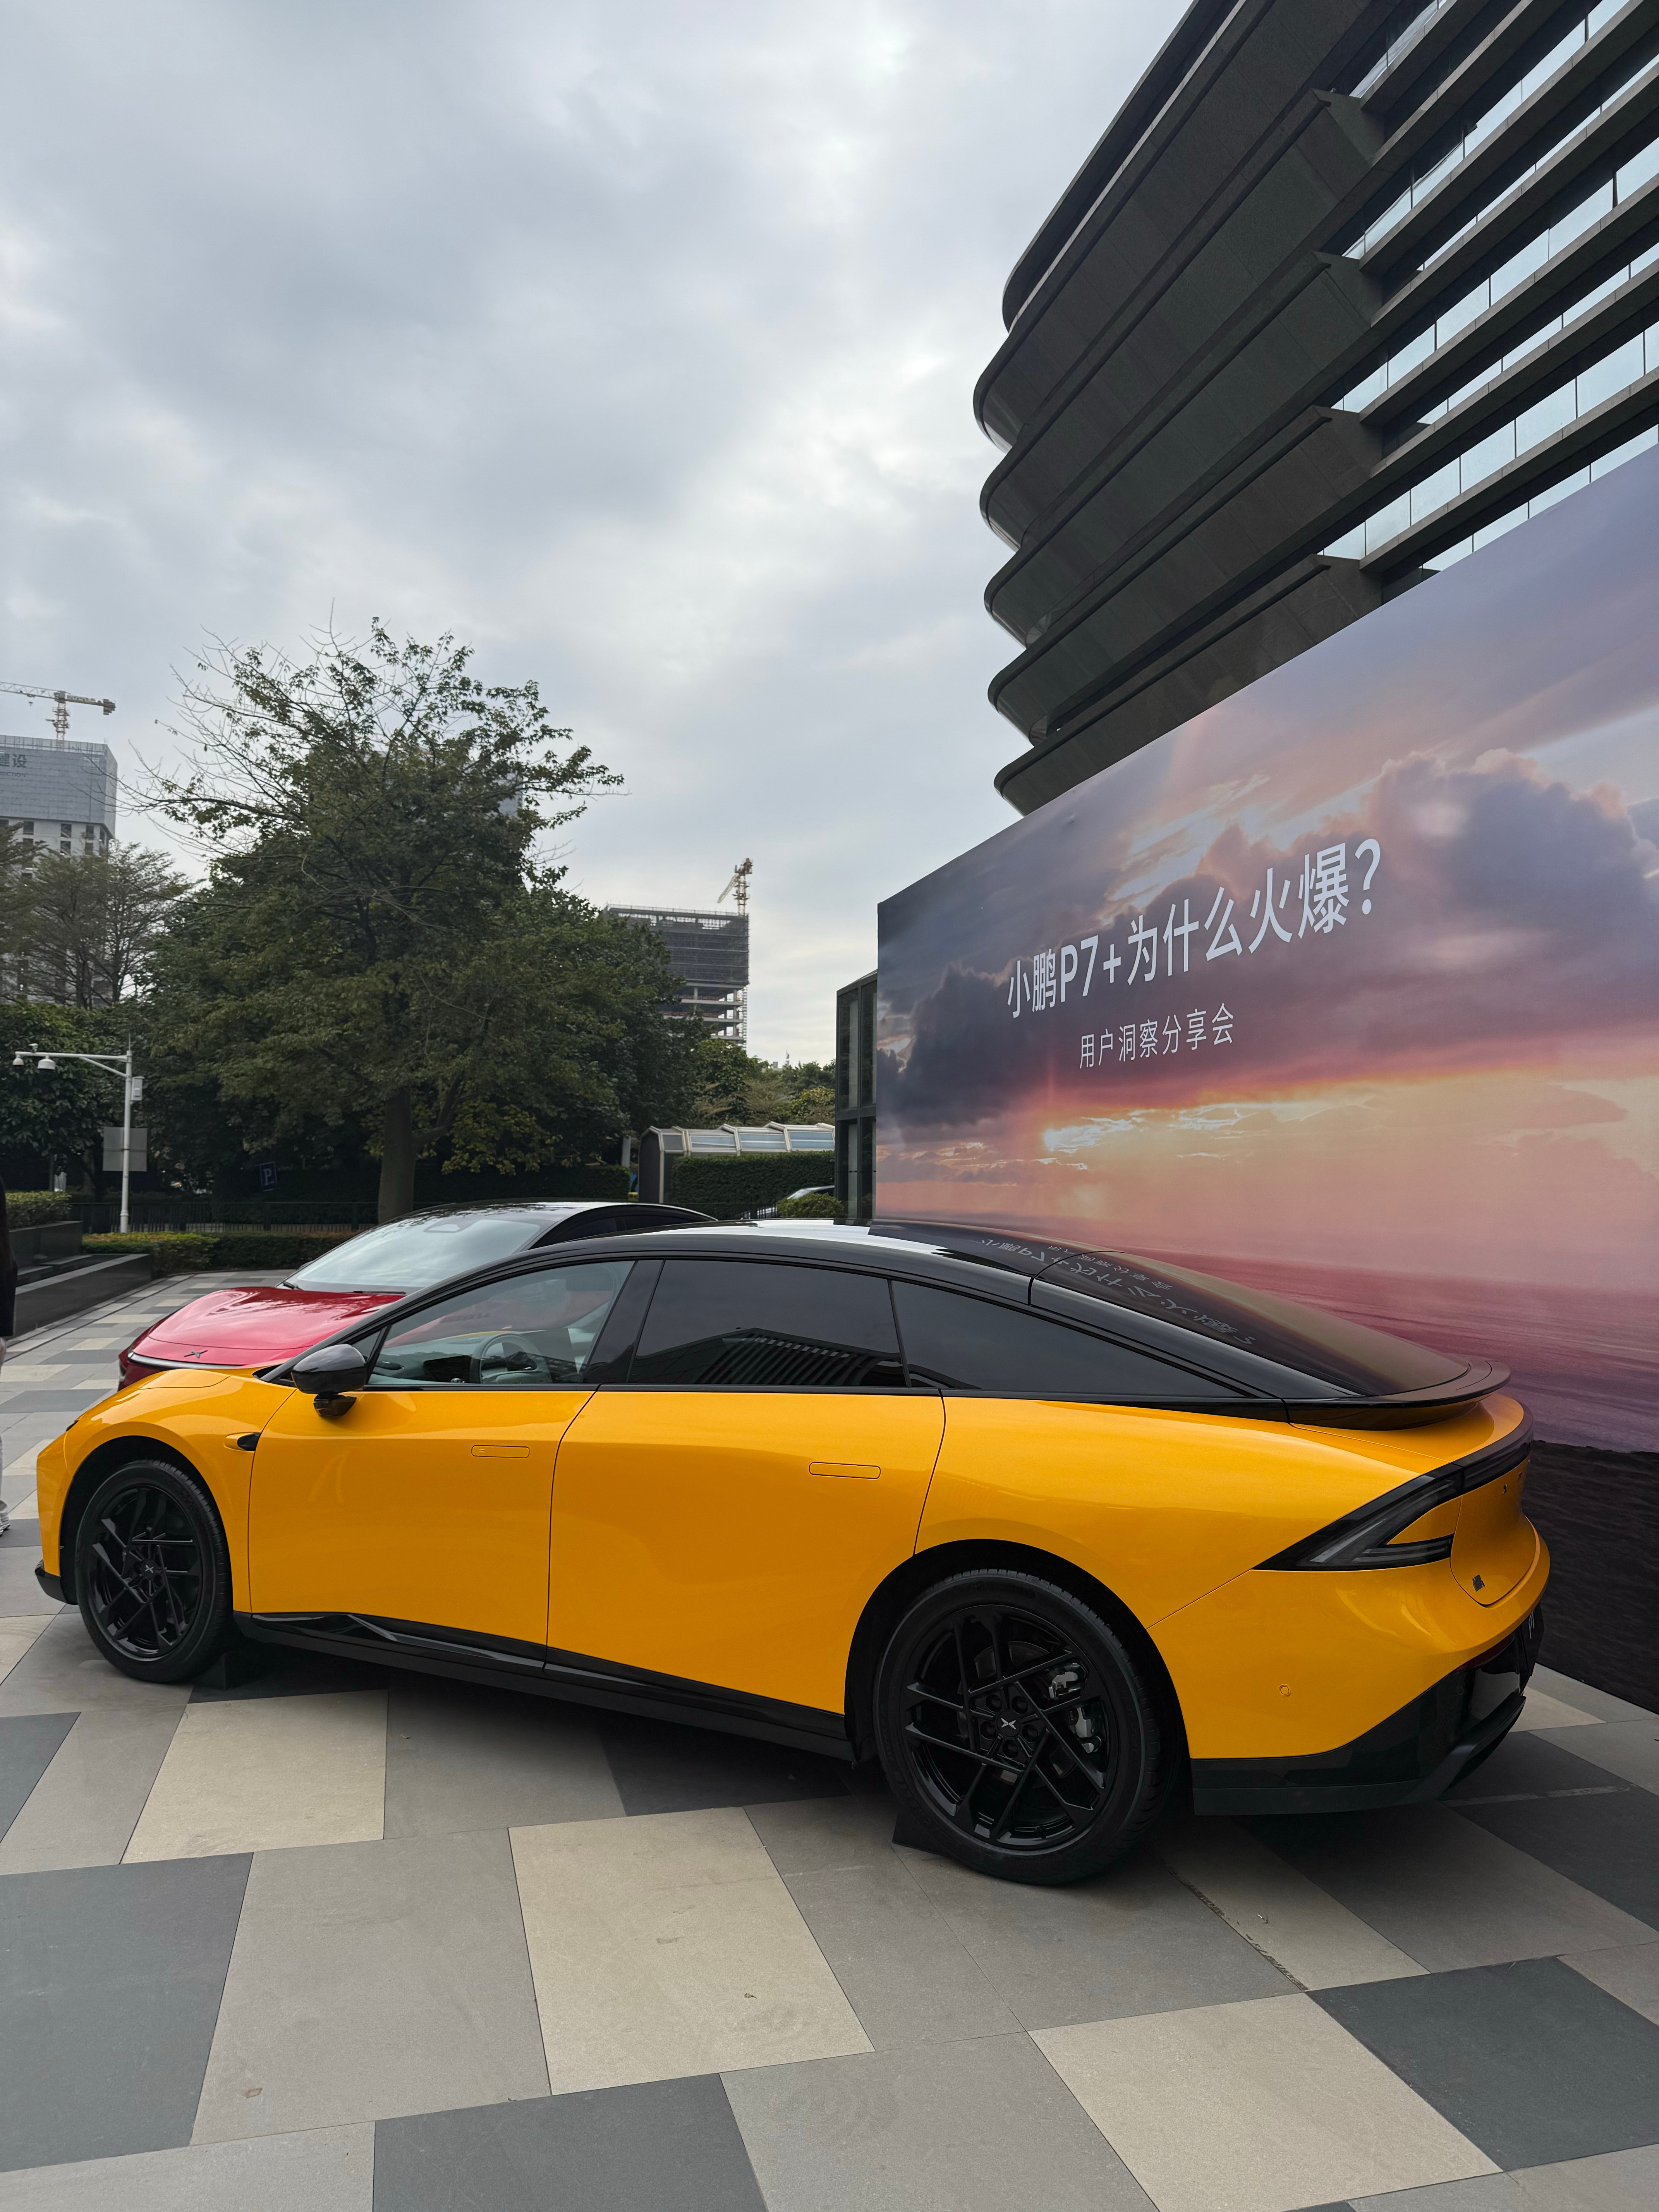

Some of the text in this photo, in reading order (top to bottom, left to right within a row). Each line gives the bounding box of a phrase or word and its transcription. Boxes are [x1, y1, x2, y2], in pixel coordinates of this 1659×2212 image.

[1007, 838, 1381, 1018] 小鹏P7+为什么火爆?
[1079, 1003, 1234, 1068] 用户洞察分享会
[263, 1168, 272, 1185] P
